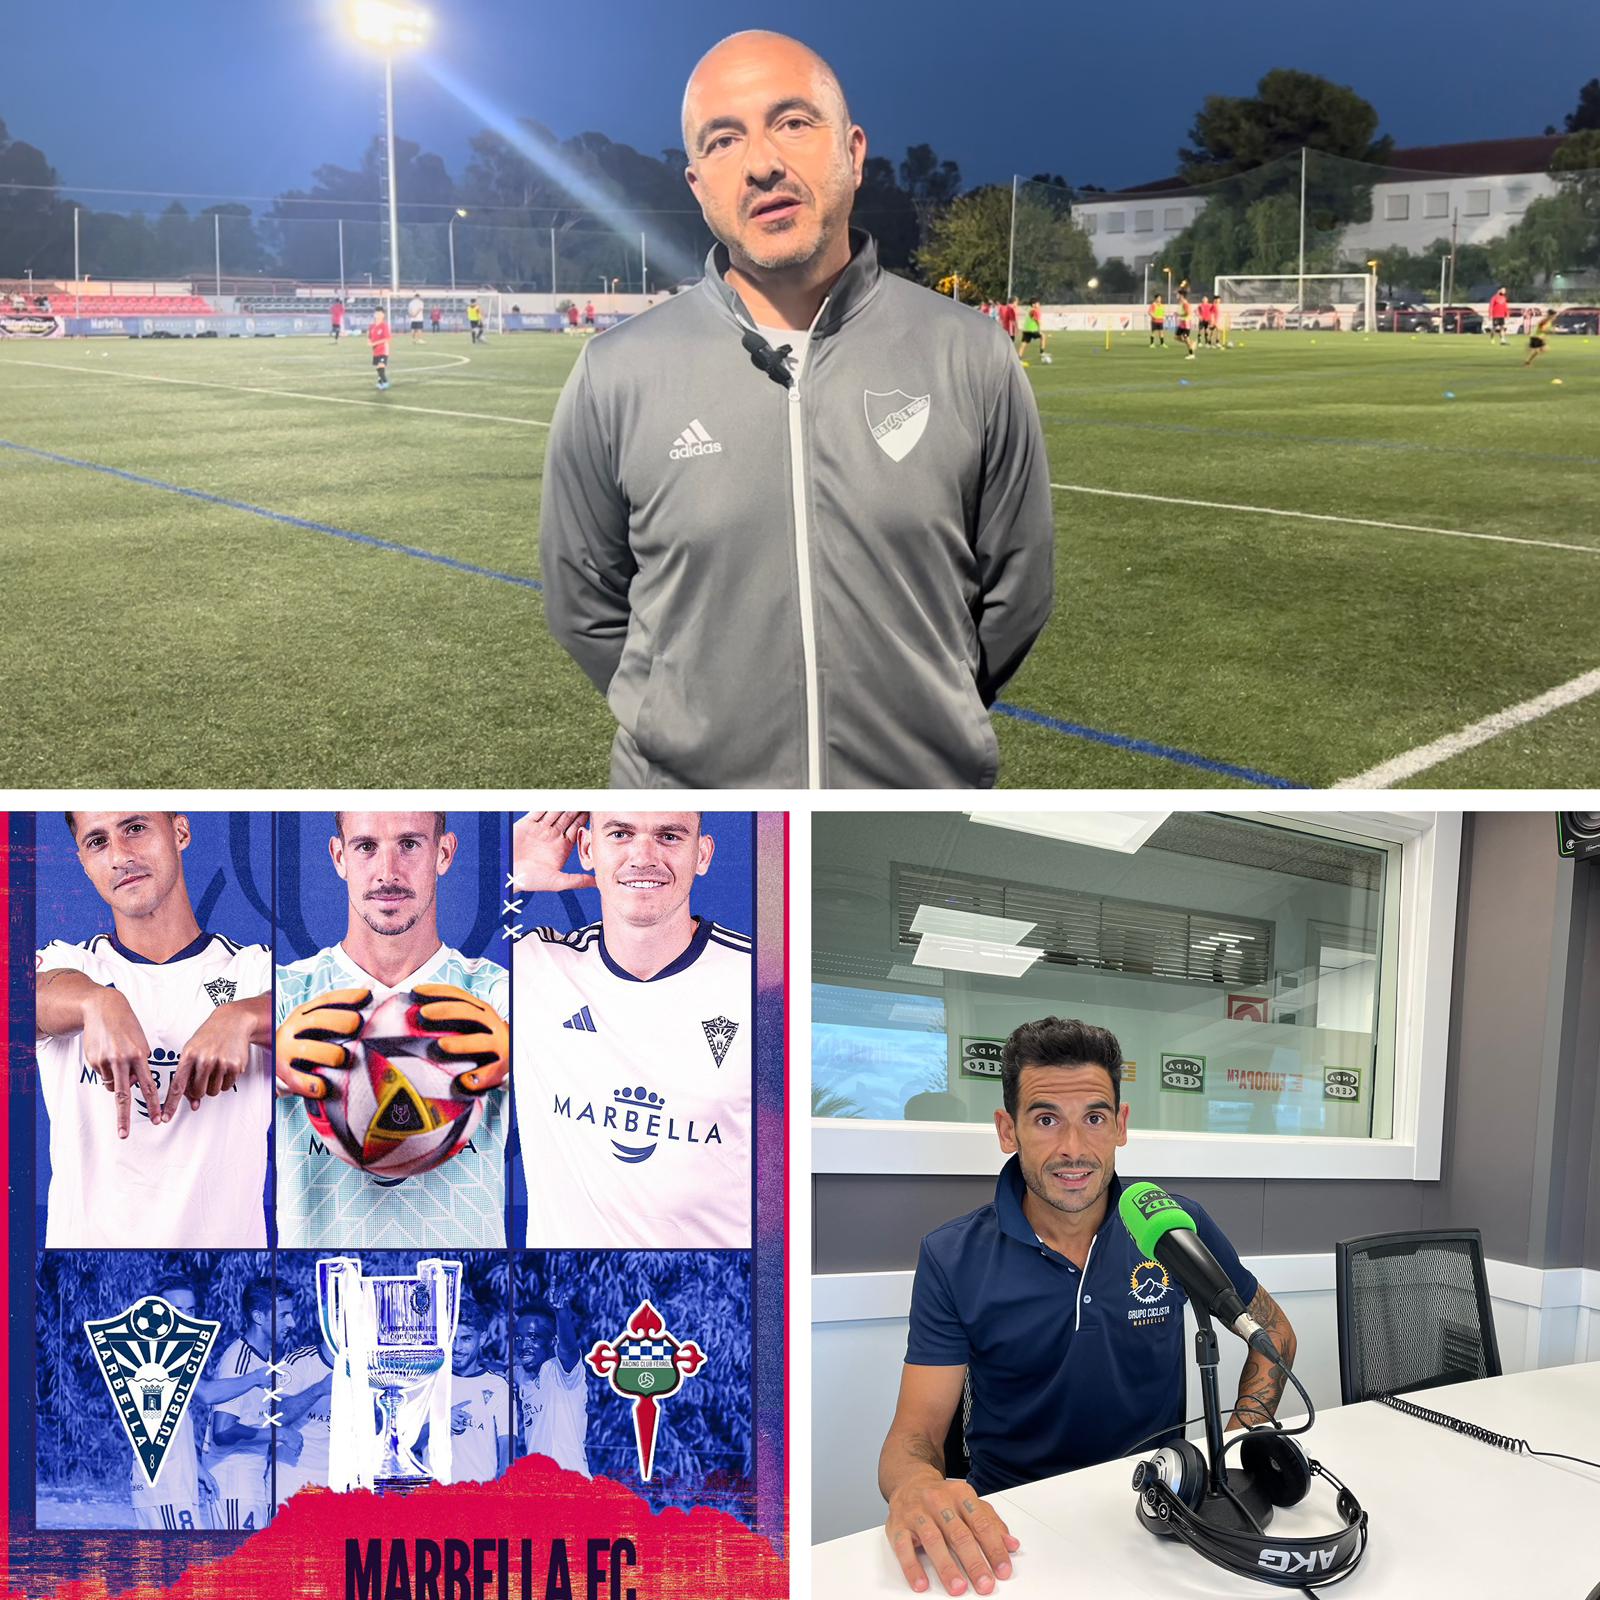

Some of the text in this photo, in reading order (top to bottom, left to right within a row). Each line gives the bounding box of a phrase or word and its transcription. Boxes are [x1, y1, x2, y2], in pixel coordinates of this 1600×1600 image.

[669, 441, 722, 460] adidas
[554, 1094, 722, 1144] MARBELLA
[1127, 1305, 1170, 1320] GRUPO CICLISTA
[186, 1329, 212, 1374] CLUB
[92, 1330, 148, 1448] MARBELLA
[155, 1381, 191, 1448] FUTBOL
[345, 1537, 637, 1600] MARBELLA FC
[1258, 1545, 1339, 1573] AKG
